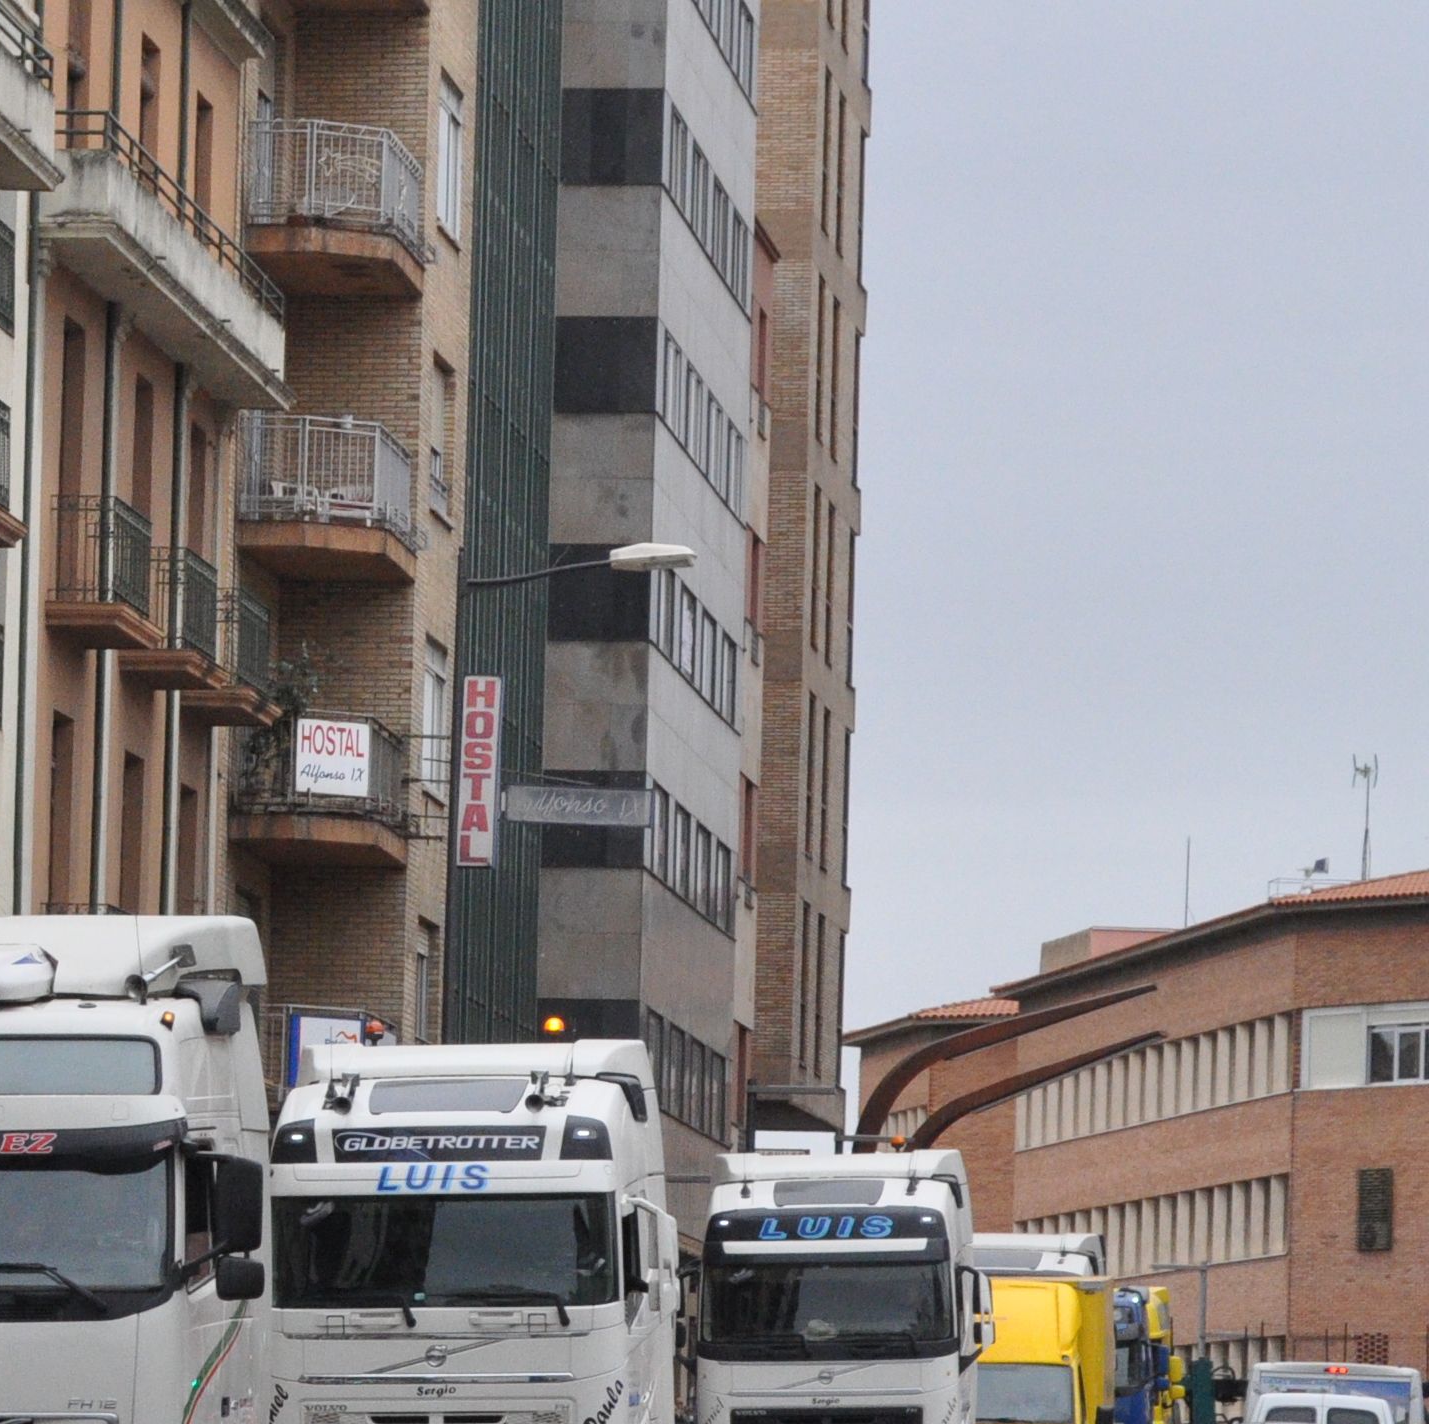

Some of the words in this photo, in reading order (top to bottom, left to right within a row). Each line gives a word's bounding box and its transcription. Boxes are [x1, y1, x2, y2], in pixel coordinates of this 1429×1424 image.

[301, 723, 365, 757] HOSTAL
[300, 763, 346, 783] Alfonso
[351, 767, 365, 782] IX
[459, 679, 496, 863] HOSTAL
[343, 1135, 540, 1151] GLOBETROTTER
[376, 1163, 490, 1191] LUIS
[758, 1215, 894, 1240] LUIS
[416, 1384, 456, 1398] Sergio
[811, 1397, 841, 1405] Sergio
[304, 1404, 348, 1412] VOLVO
